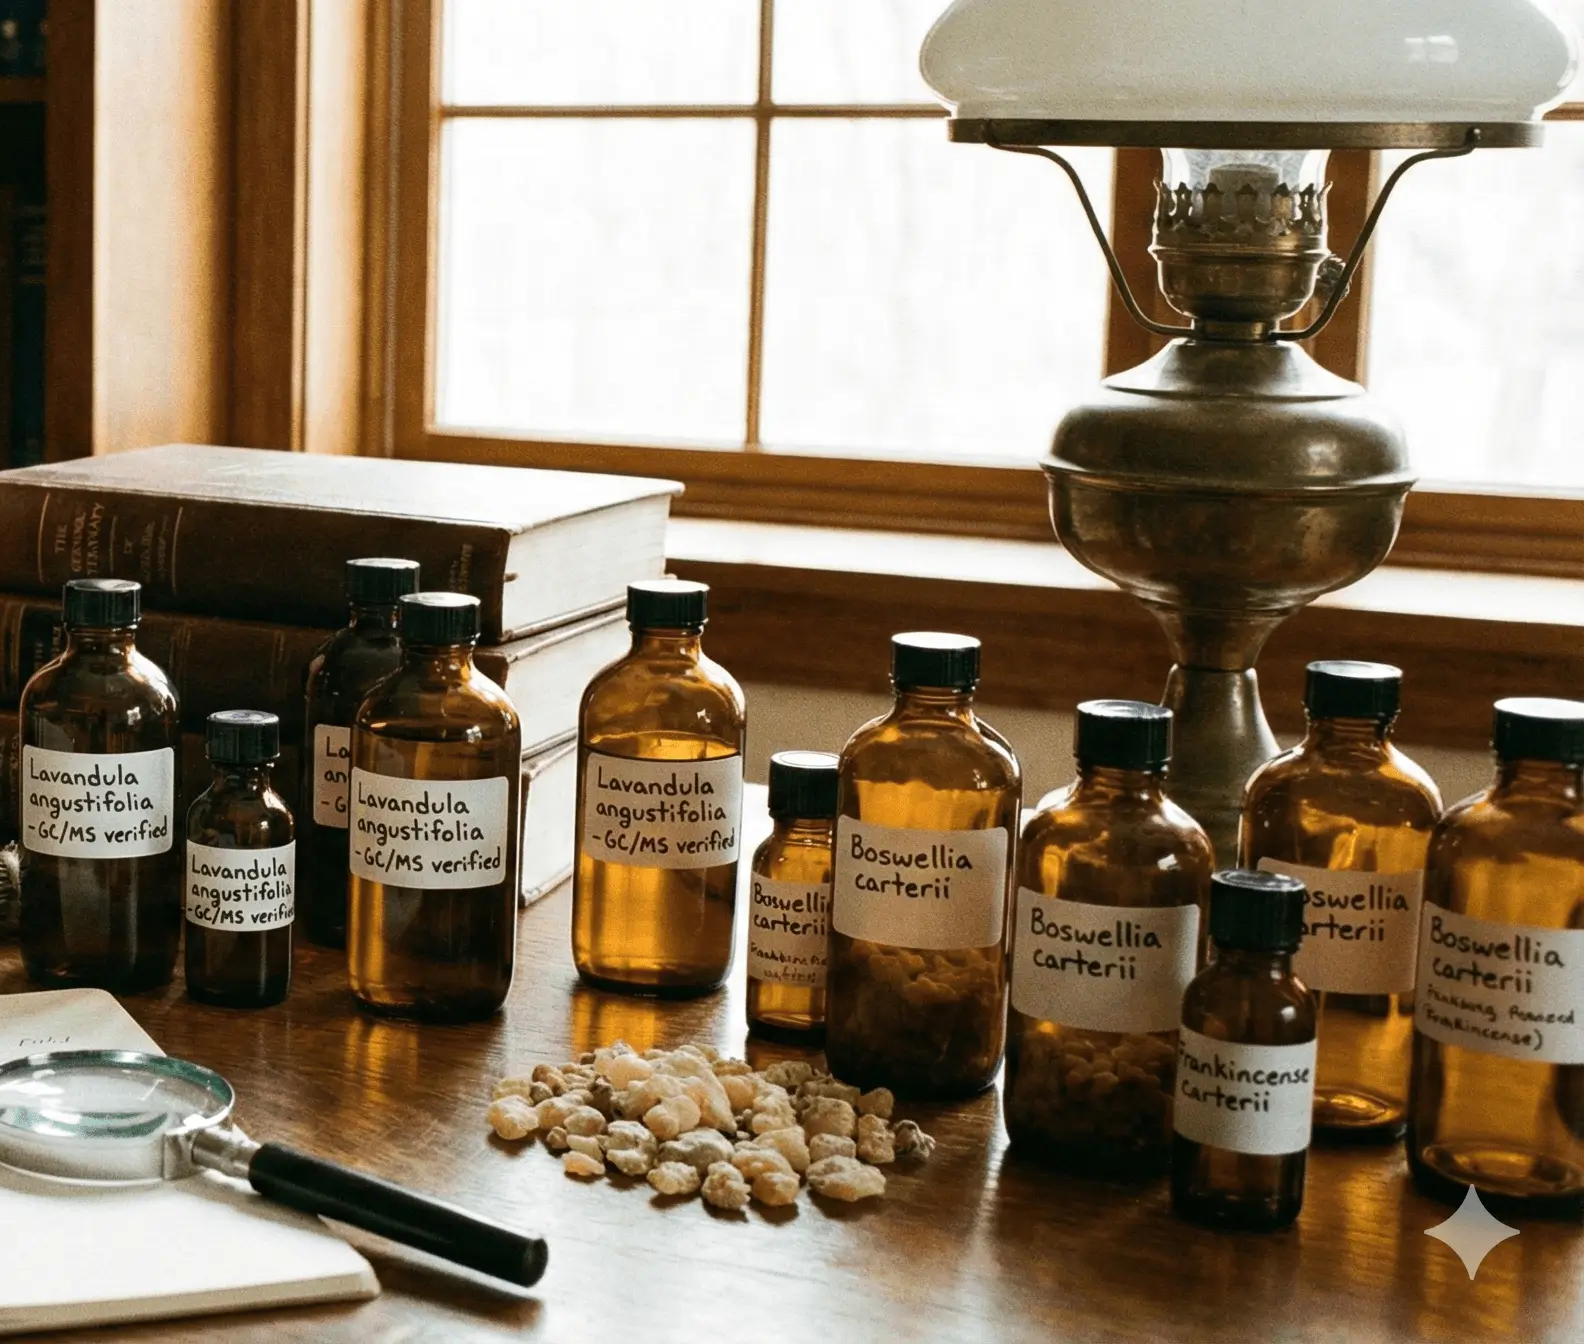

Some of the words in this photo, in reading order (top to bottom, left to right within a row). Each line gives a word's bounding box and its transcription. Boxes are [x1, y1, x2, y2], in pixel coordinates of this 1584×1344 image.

[30, 757, 139, 786] Lavandula
[597, 765, 715, 796] Lavandula
[29, 790, 154, 819] angustifolia
[358, 781, 470, 814] Lavandula
[596, 800, 727, 829] angustifolia
[103, 815, 168, 844] verified
[357, 818, 484, 846] angustifolia
[676, 827, 735, 854] verified
[431, 846, 501, 874] verified
[851, 834, 973, 870] Boswellia
[191, 854, 287, 880] Lavandula
[191, 881, 292, 908] angustifolia
[855, 872, 950, 899] carterii
[753, 913, 826, 935] carterii
[1031, 907, 1162, 948] Boswellia
[1431, 915, 1565, 968] Boswellia
